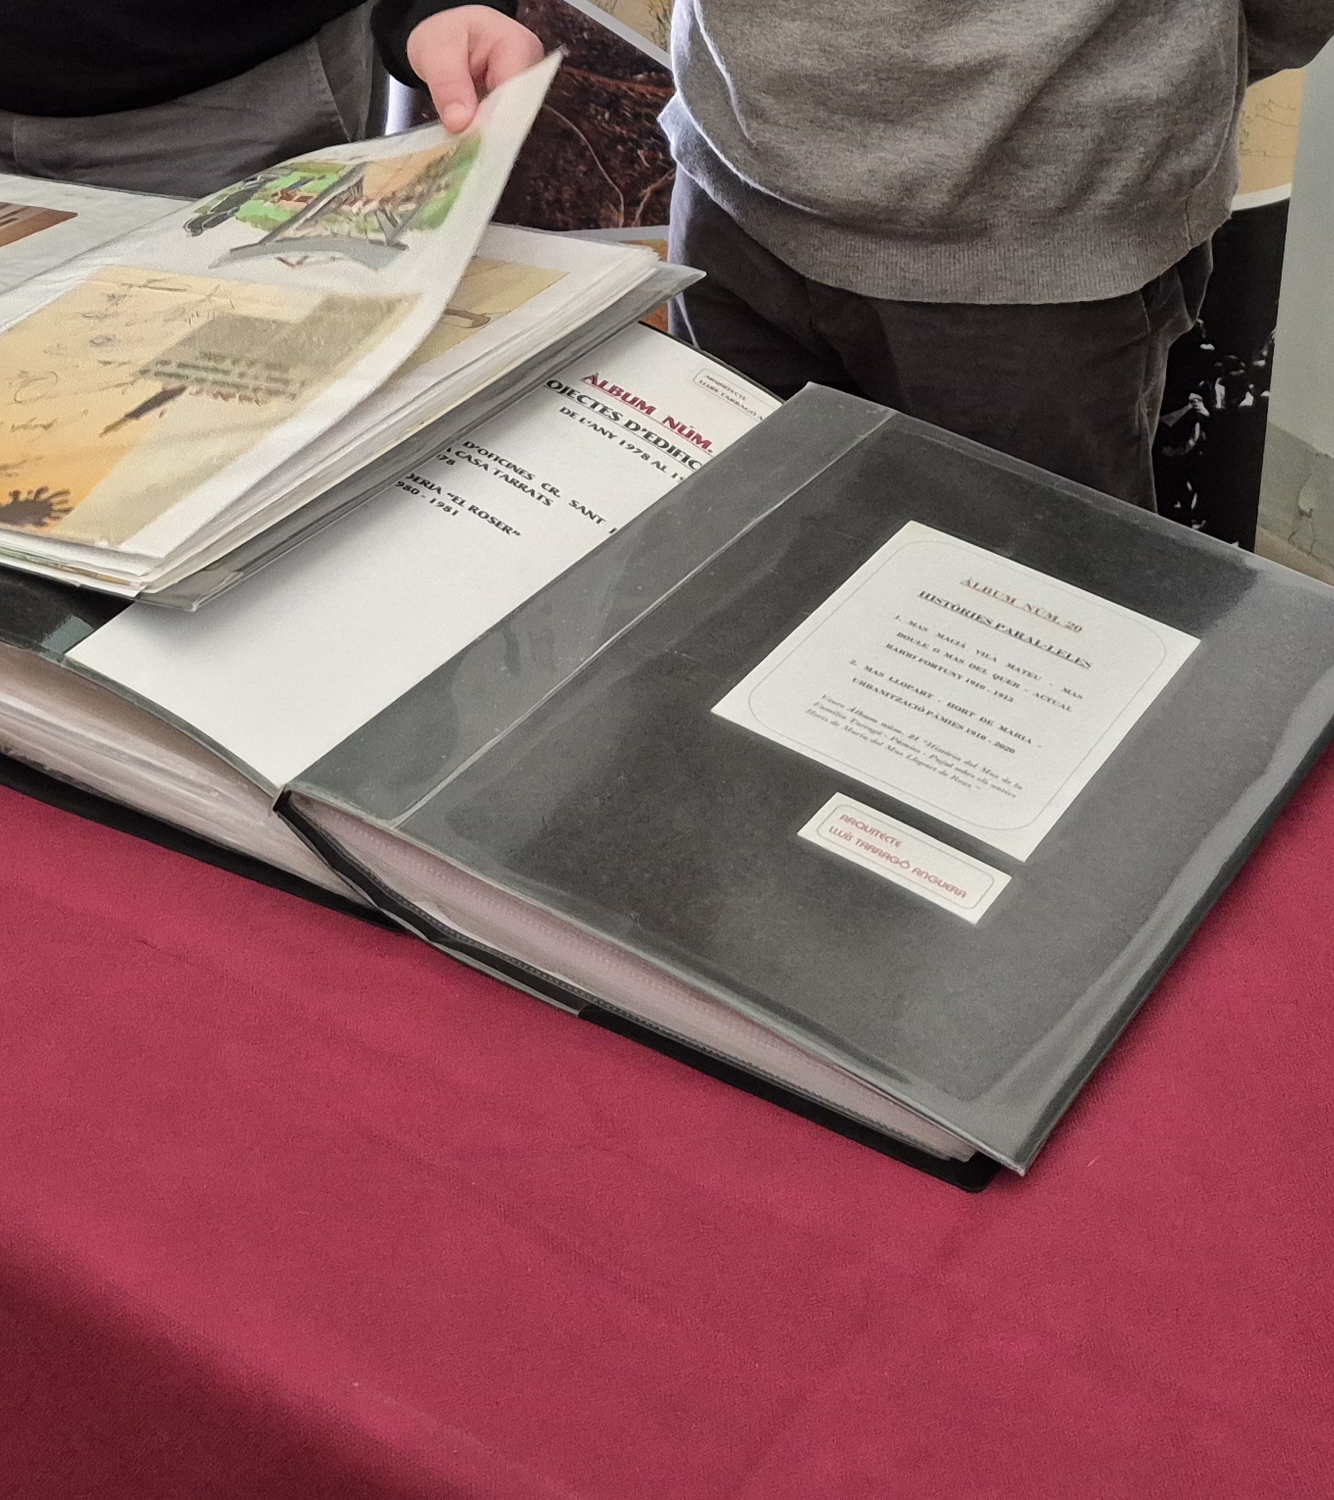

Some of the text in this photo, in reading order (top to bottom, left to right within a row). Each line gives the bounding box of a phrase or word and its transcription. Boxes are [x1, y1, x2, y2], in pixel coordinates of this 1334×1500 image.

[545, 379, 703, 471] OJECTES D'EDIFIC
[559, 406, 667, 474] DE L'ANY 1978 AL
[580, 372, 714, 454] ÀLBUM NÚM.
[394, 480, 421, 496] 980
[429, 497, 459, 517] 1981
[454, 450, 554, 507] CASA TARRATS
[540, 482, 561, 498] CR.
[568, 499, 606, 526] SANT
[906, 619, 930, 633] MAS
[916, 590, 994, 628] HISTÒRIES
[959, 576, 1018, 606] ÀLBUM
[1062, 620, 1084, 634] 20
[917, 657, 964, 681] FORTUNY
[942, 651, 966, 665] MAS
[967, 662, 989, 676] DEL
[1032, 691, 1072, 713] ACTUAL
[862, 664, 886, 678] MAS
[945, 701, 977, 718] HORT
[978, 716, 995, 727] DE
[996, 724, 1032, 745] MARIA
[839, 813, 903, 849] ARQUITECTE
[854, 837, 911, 870] TARRAGÓ
[911, 866, 968, 900] ANGUERA
